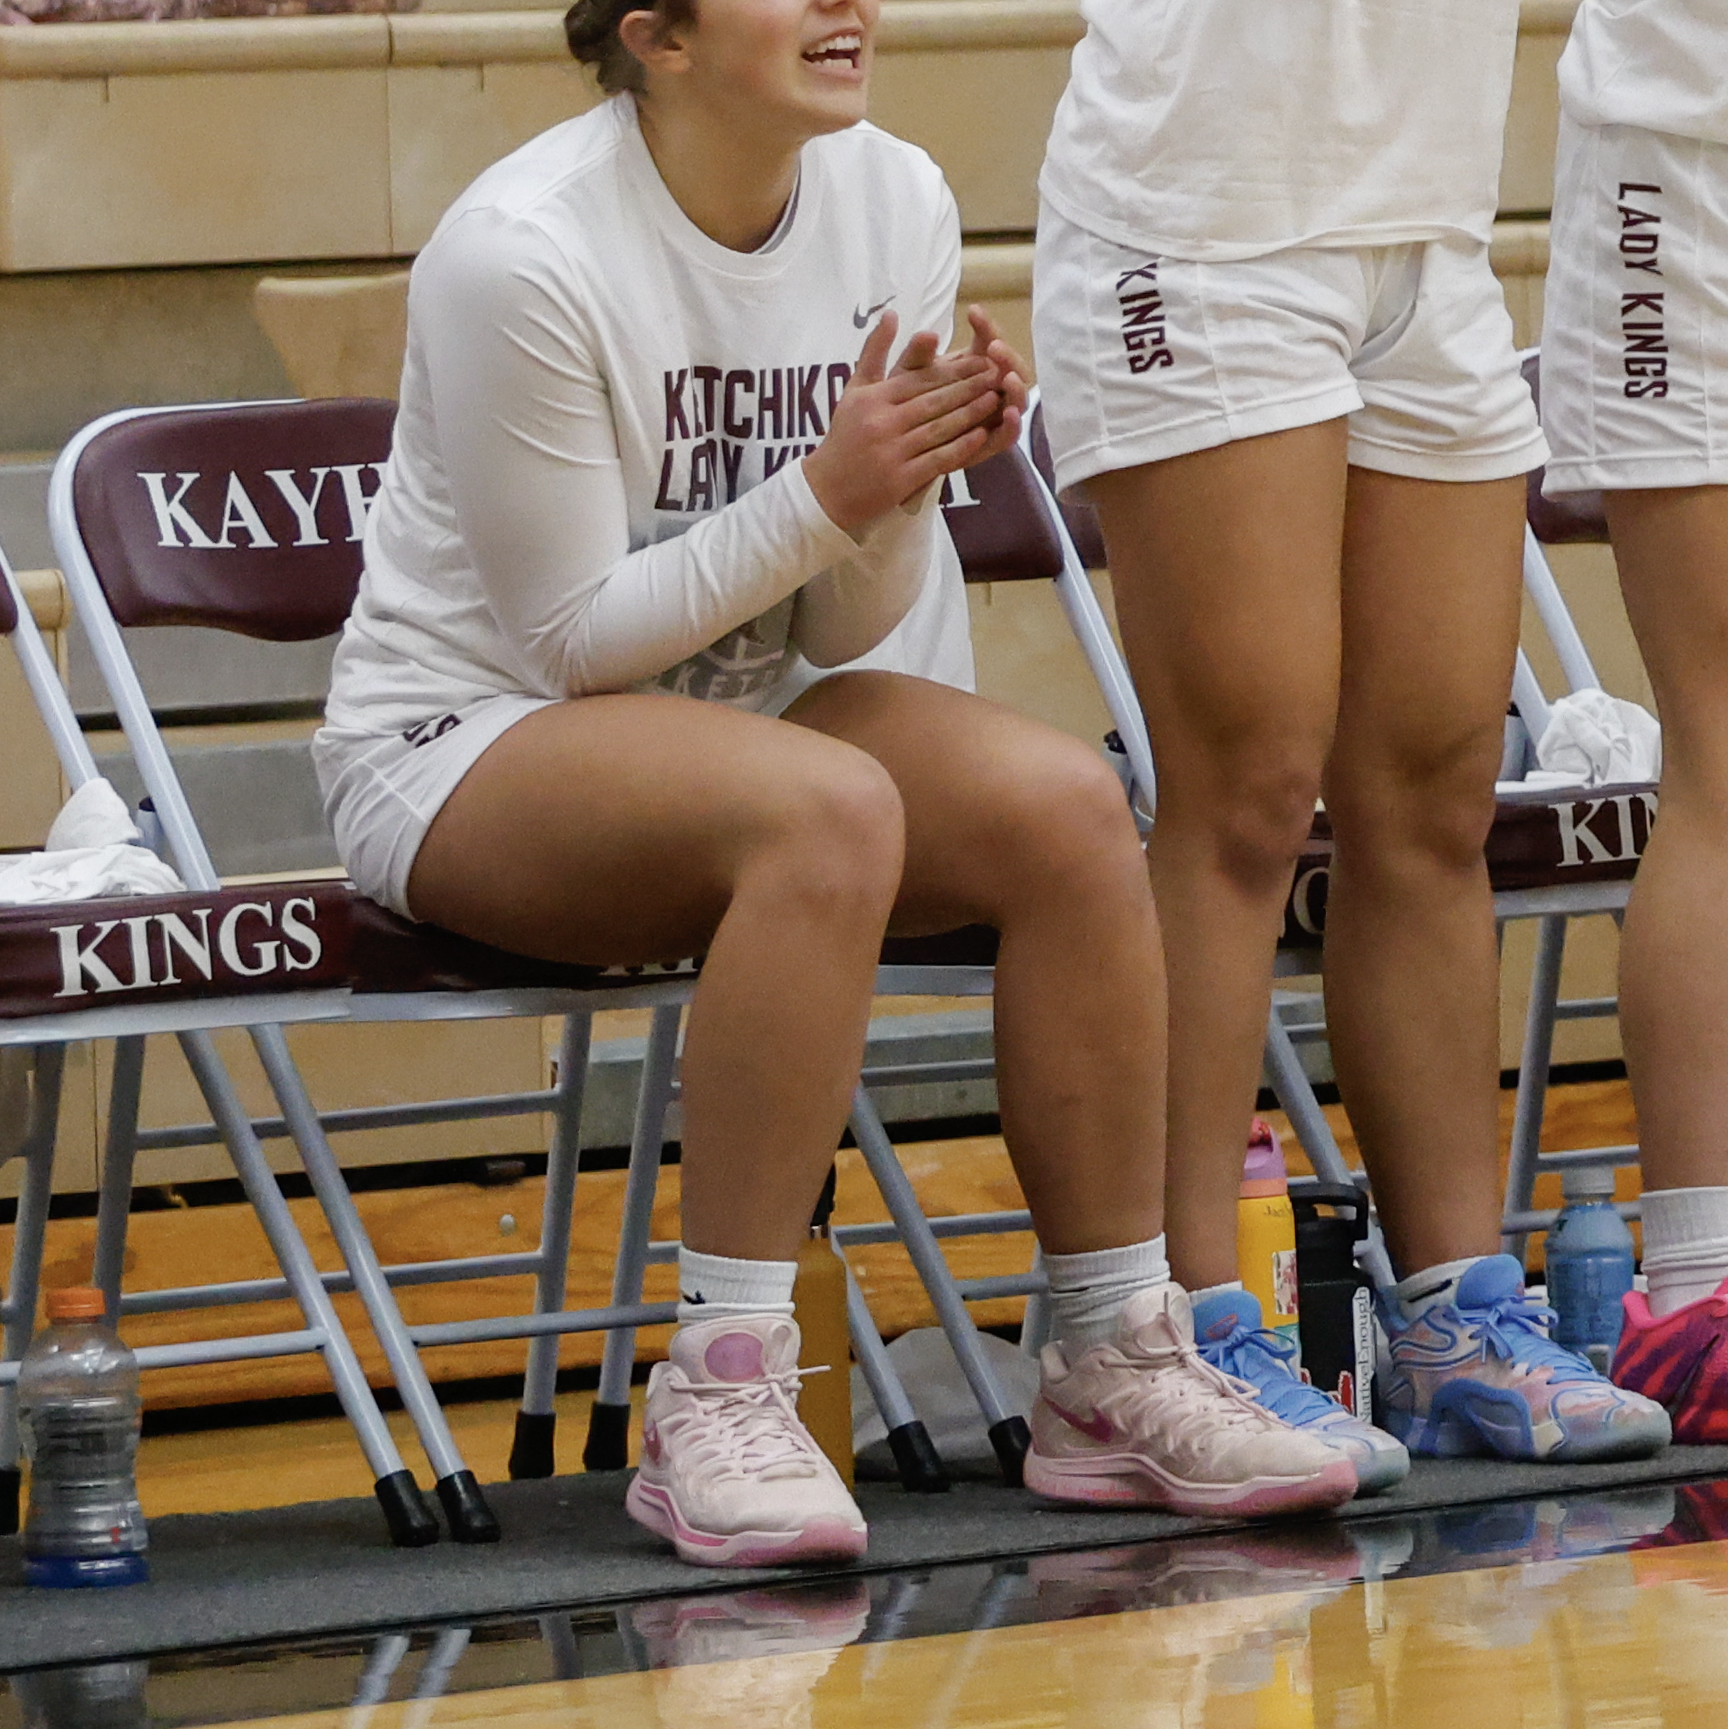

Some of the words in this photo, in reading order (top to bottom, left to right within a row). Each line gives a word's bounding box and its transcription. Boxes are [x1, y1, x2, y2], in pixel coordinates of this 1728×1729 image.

[1617, 182, 1664, 277] LADY
[1116, 261, 1175, 374] KINGS
[1620, 292, 1669, 398] KINGS
[137, 462, 390, 549] KAYH
[50, 896, 323, 999] KINGS
